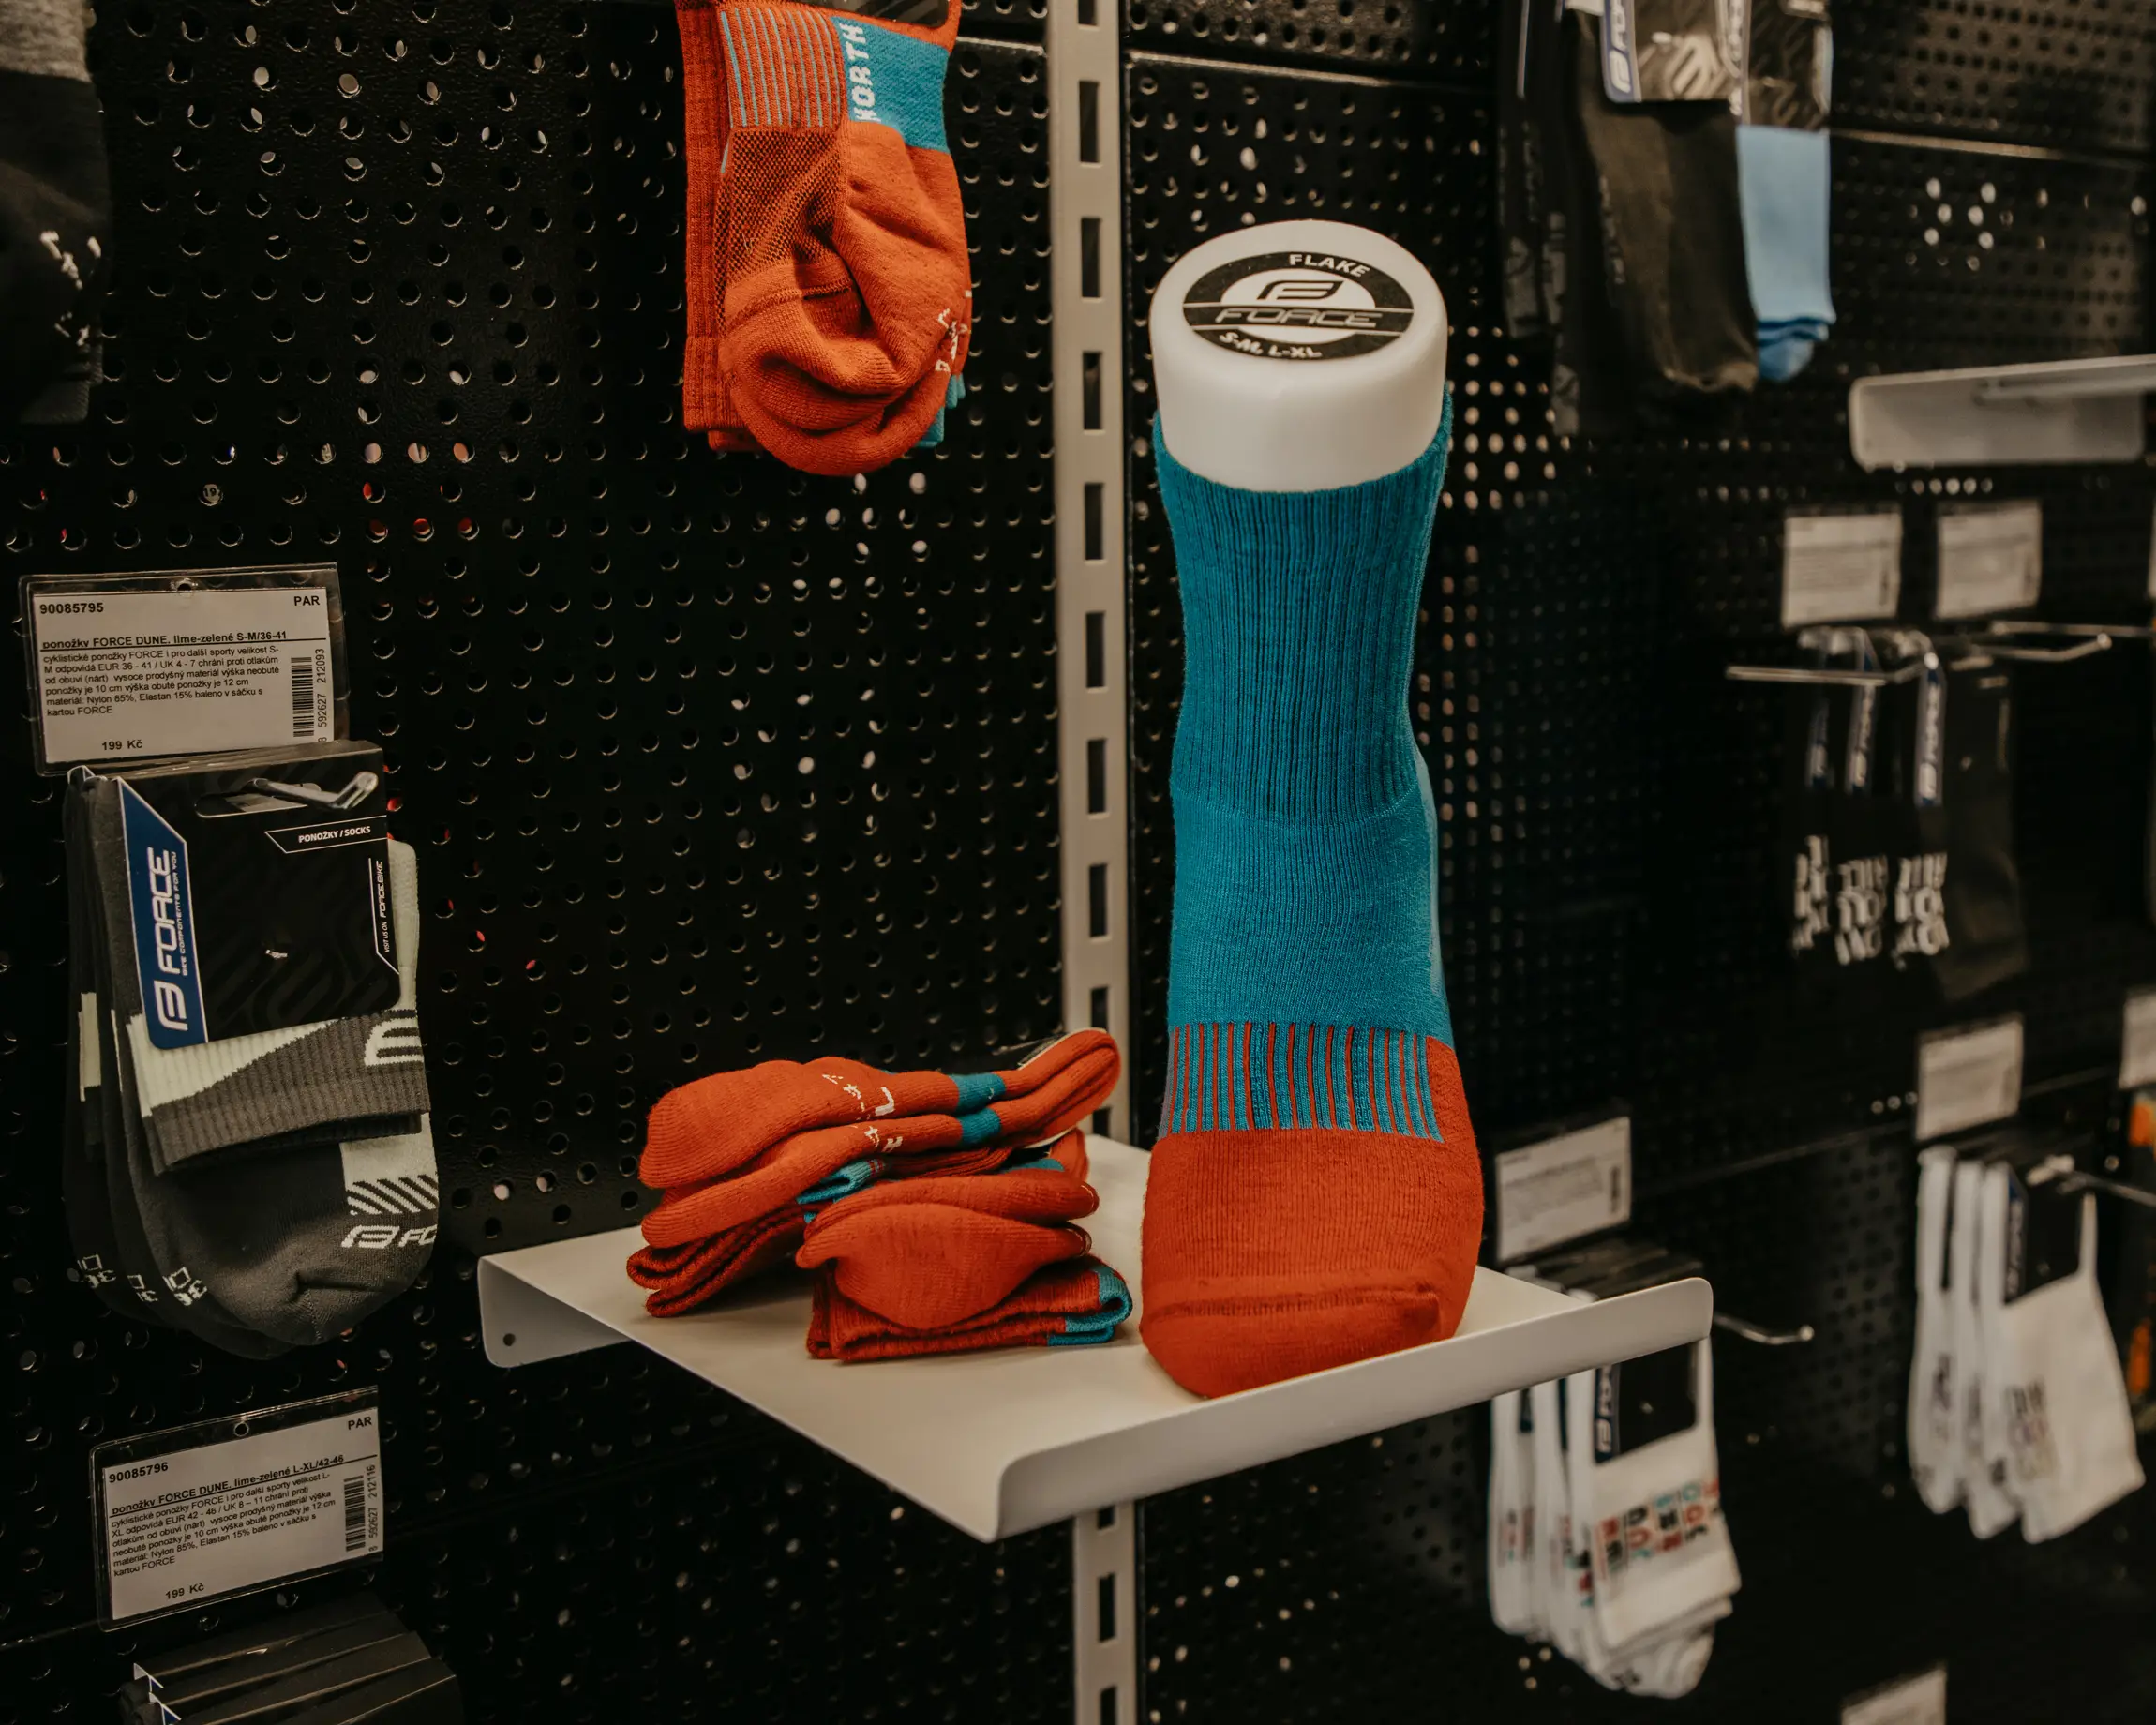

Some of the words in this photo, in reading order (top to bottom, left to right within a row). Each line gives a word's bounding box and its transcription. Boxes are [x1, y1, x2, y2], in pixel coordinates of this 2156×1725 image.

[839, 22, 881, 122] NORTH
[1289, 254, 1370, 278] FLAKE
[1215, 308, 1383, 328] FORCE
[1268, 345, 1323, 358] L-XL
[39, 602, 104, 614] 90085795
[293, 595, 321, 607] PAR
[92, 637, 132, 646] FORCE
[173, 632, 234, 643] lime-zelené
[236, 630, 286, 641] S-M/36-41
[128, 650, 163, 659] FORCE
[171, 651, 186, 659] pro
[209, 648, 235, 657] sporty
[236, 646, 267, 654] velikost
[97, 662, 119, 671] EUR
[121, 662, 133, 670] 36
[141, 661, 151, 669] 41
[159, 660, 173, 668] UK
[226, 657, 245, 668] proti
[315, 648, 326, 683] 212093
[44, 676, 56, 684] od
[112, 673, 143, 682] vysoce
[83, 685, 93, 696] je
[95, 684, 107, 693] 10
[213, 679, 221, 689] je
[223, 678, 233, 686] 12
[85, 694, 112, 706] Nylon
[139, 693, 172, 701] Elastan
[174, 689, 193, 699] 15%
[194, 687, 223, 698] baleno
[46, 708, 75, 716] kartou
[77, 706, 112, 715] FORCE
[318, 693, 327, 728] 592627
[101, 740, 123, 751] 199
[127, 739, 142, 749] Kč
[298, 830, 338, 843] PONOŽKY
[344, 825, 371, 837] SOCKS
[172, 873, 181, 892] FOR
[376, 860, 387, 919] FORCE.BIKE
[147, 847, 180, 974] FORCE
[381, 922, 388, 931] ON
[348, 1417, 372, 1430] PAR
[109, 1461, 169, 1483] 90085796
[158, 1488, 196, 1504] FORCE
[234, 1466, 291, 1487] lime-zelené
[292, 1454, 344, 1473] L-XL/42-46
[165, 1587, 185, 1599] 199
[189, 1582, 204, 1594] Kč
